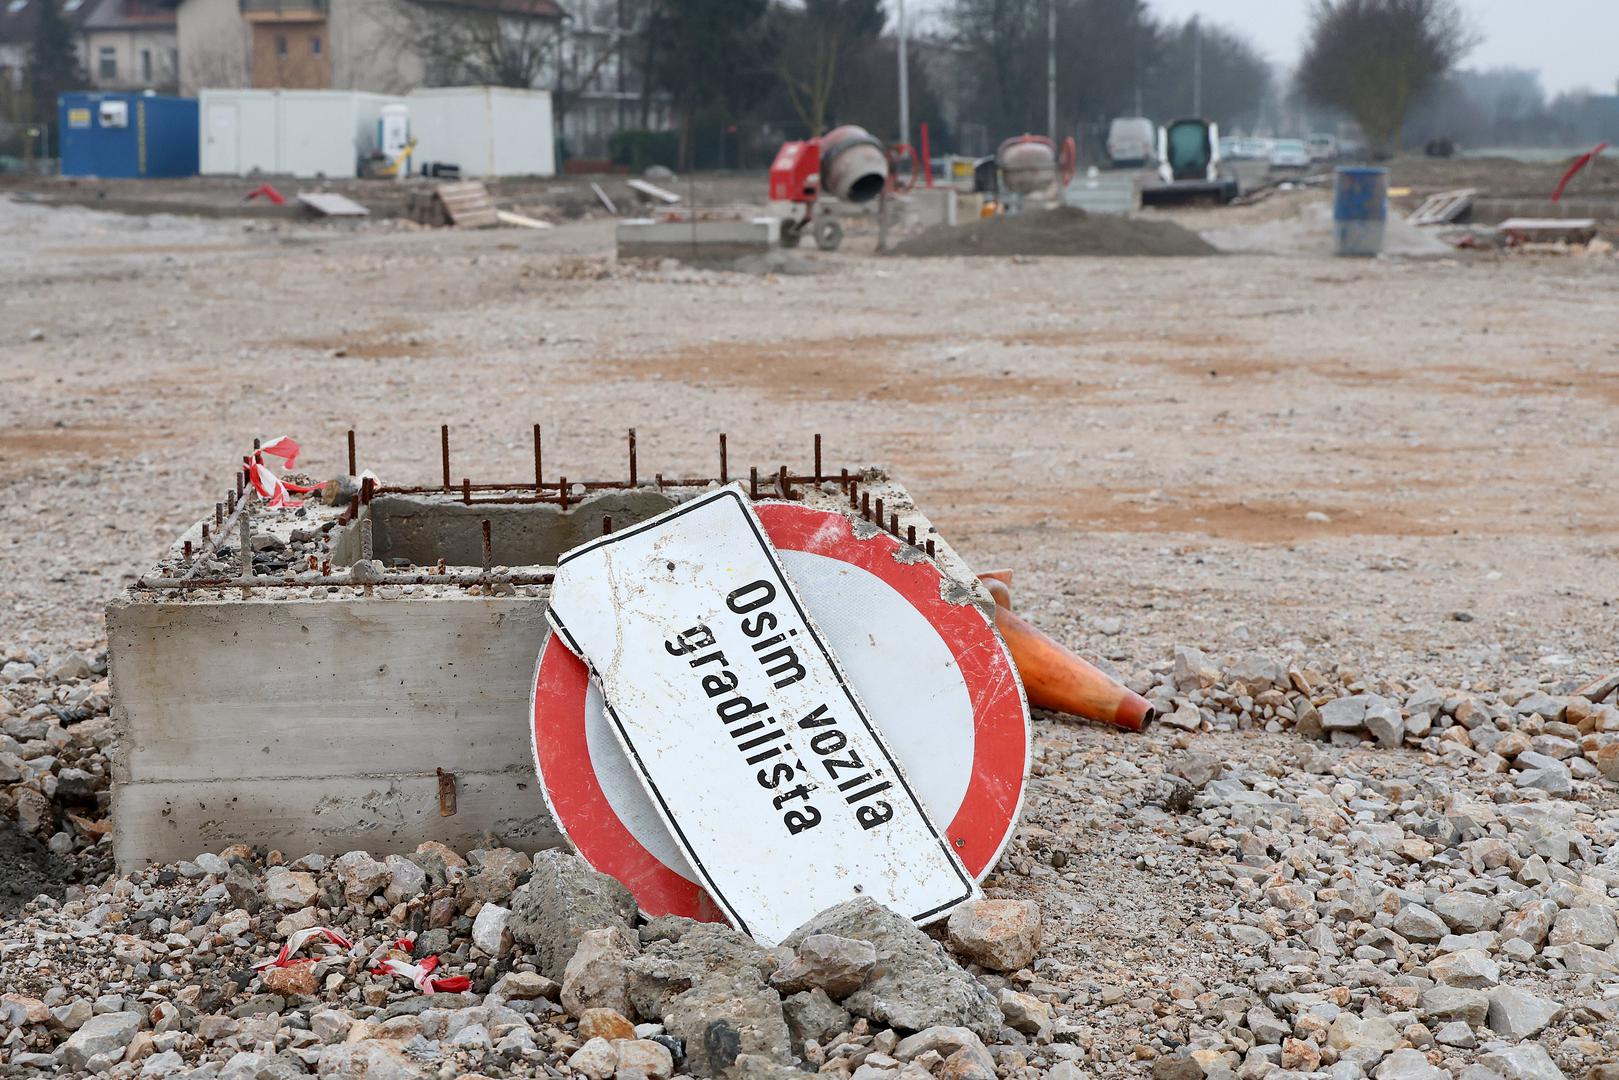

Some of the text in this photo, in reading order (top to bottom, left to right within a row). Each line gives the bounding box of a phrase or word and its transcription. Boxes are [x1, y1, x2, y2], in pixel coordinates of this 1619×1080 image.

[665, 625, 821, 835] gradilišta
[726, 580, 893, 830] Osim vozila
